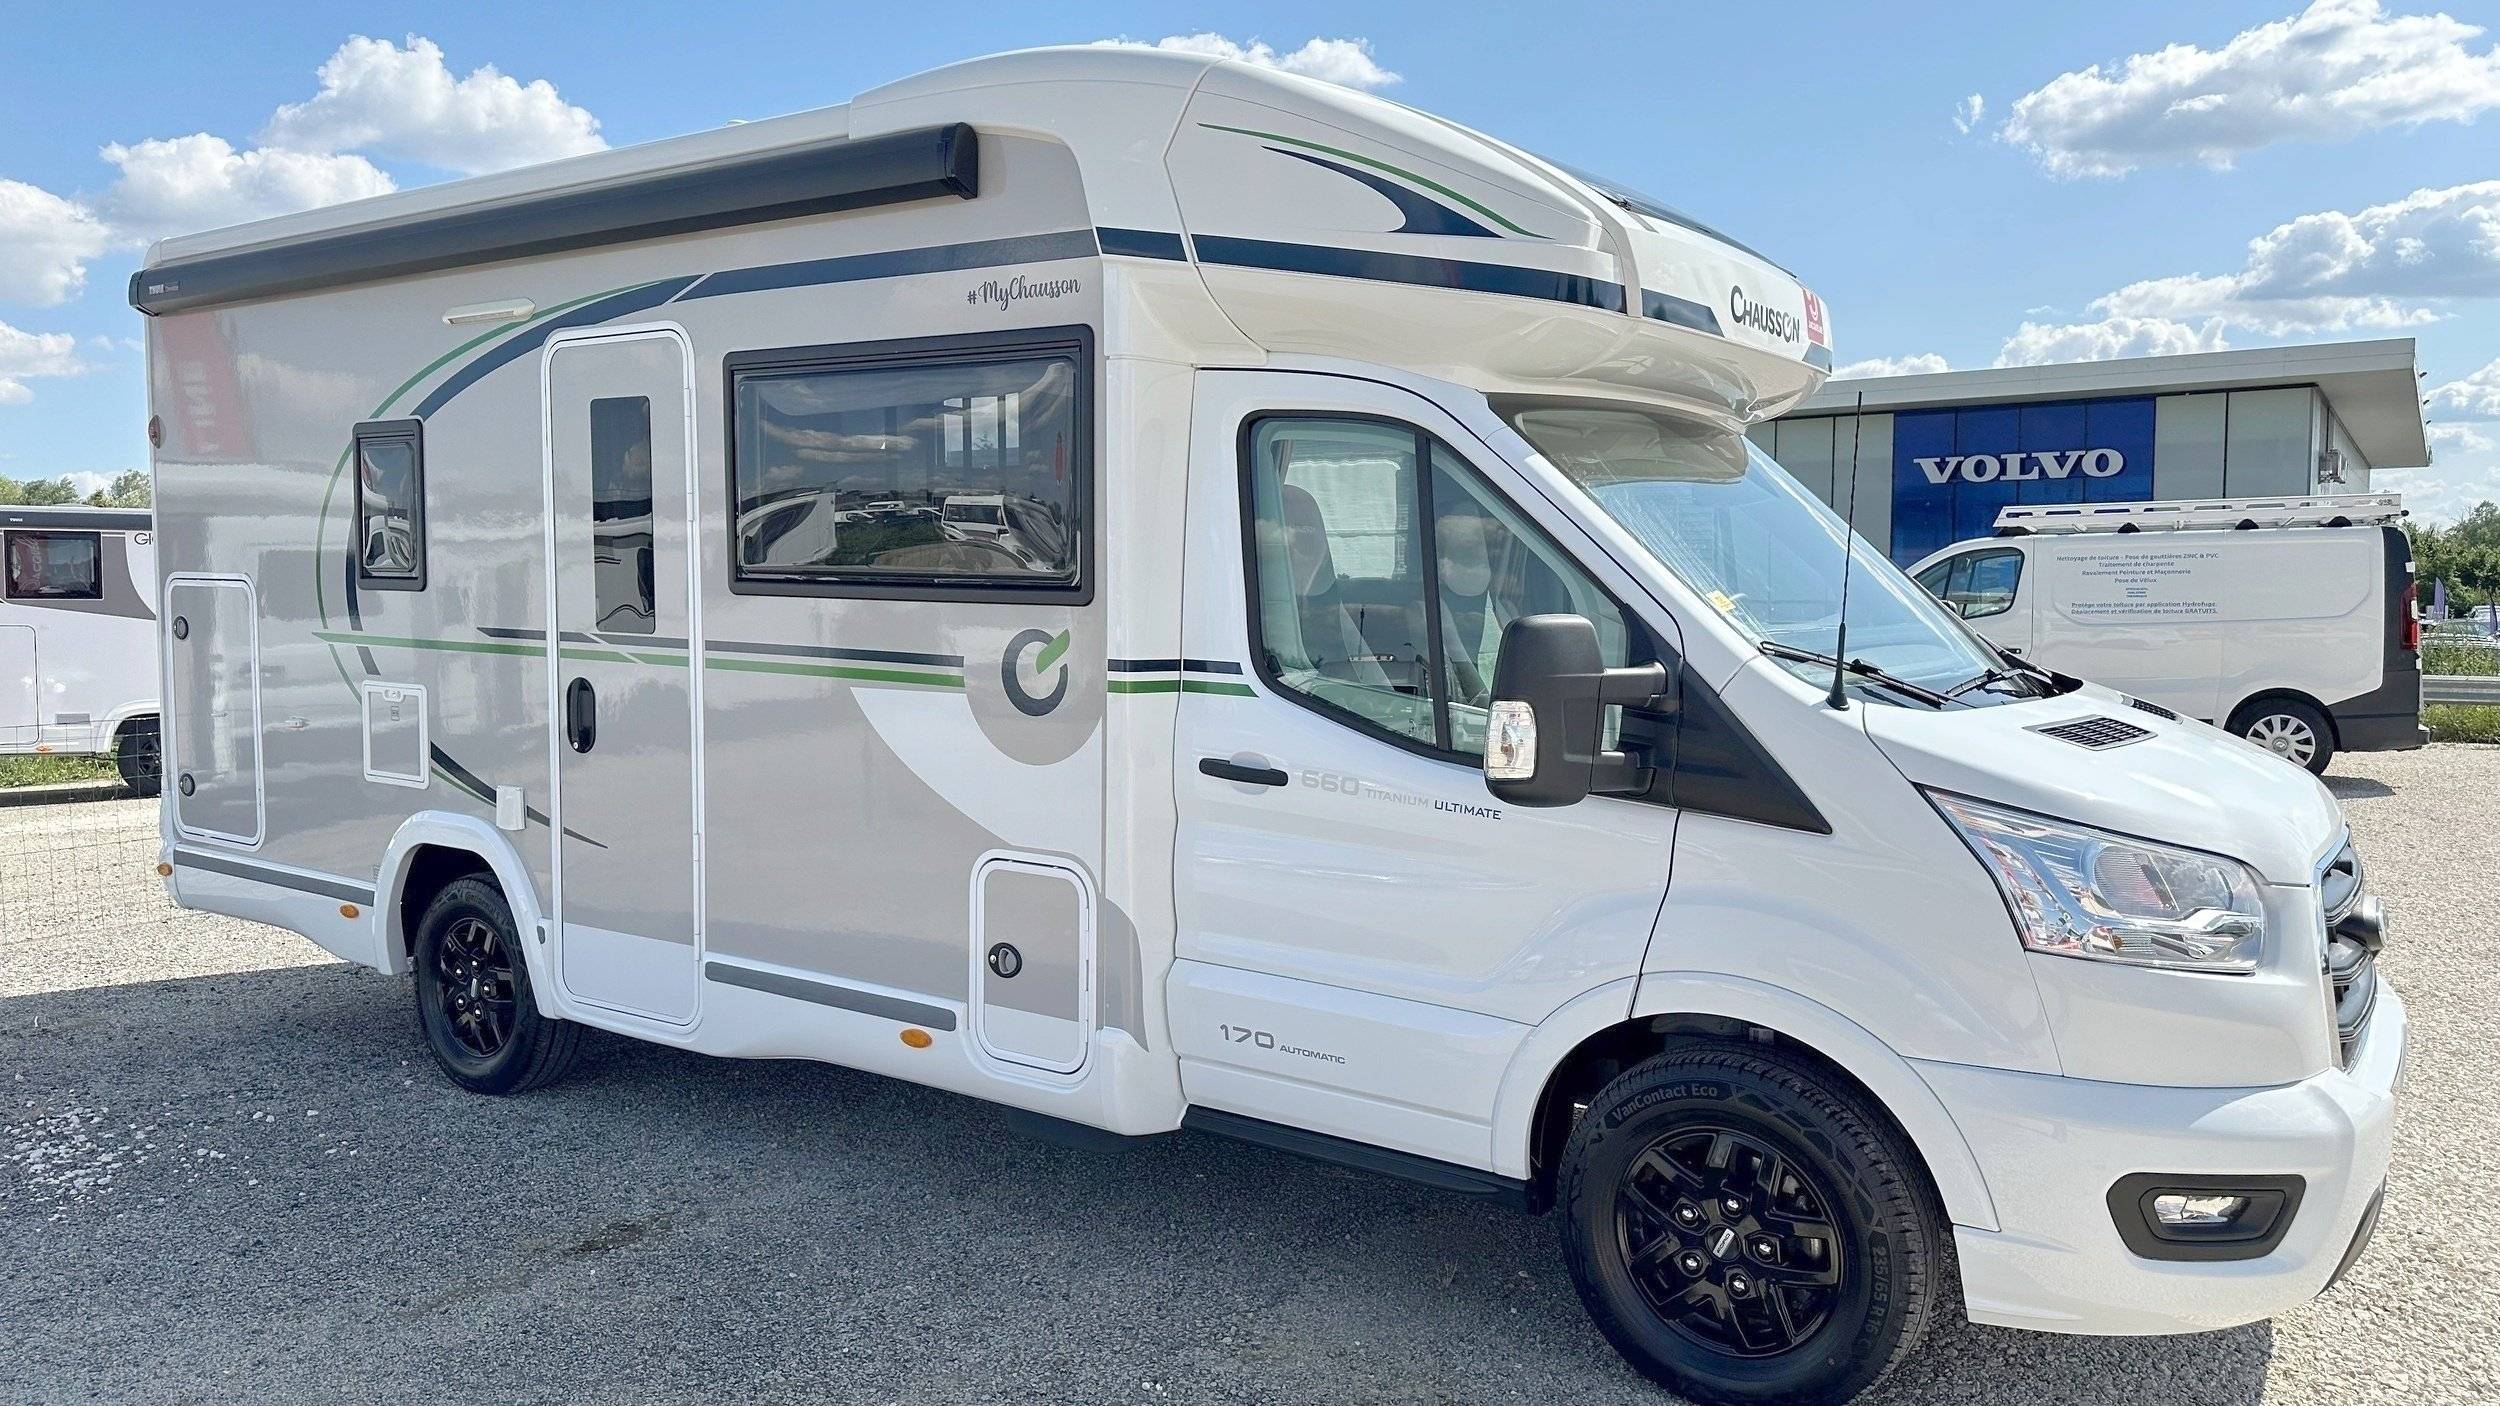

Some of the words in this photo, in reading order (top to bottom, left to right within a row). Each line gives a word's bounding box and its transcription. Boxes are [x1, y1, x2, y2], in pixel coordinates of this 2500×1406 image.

[967, 275, 1081, 311] #MyChausson
[1730, 285, 1800, 343] CHAUSSON
[1913, 448, 2124, 484] VOLVO
[134, 532, 154, 545] Gl
[1301, 769, 1360, 796] 660
[1365, 787, 1429, 808] TITANIUM
[1434, 799, 1502, 820] ULTIMATE
[1220, 1024, 1275, 1049] 170
[1279, 1044, 1346, 1064] AUTOMATIC
[1611, 1084, 1687, 1120] VanContact
[1691, 1083, 1718, 1097] Eco
[1872, 1246, 1889, 1302] 235/65
